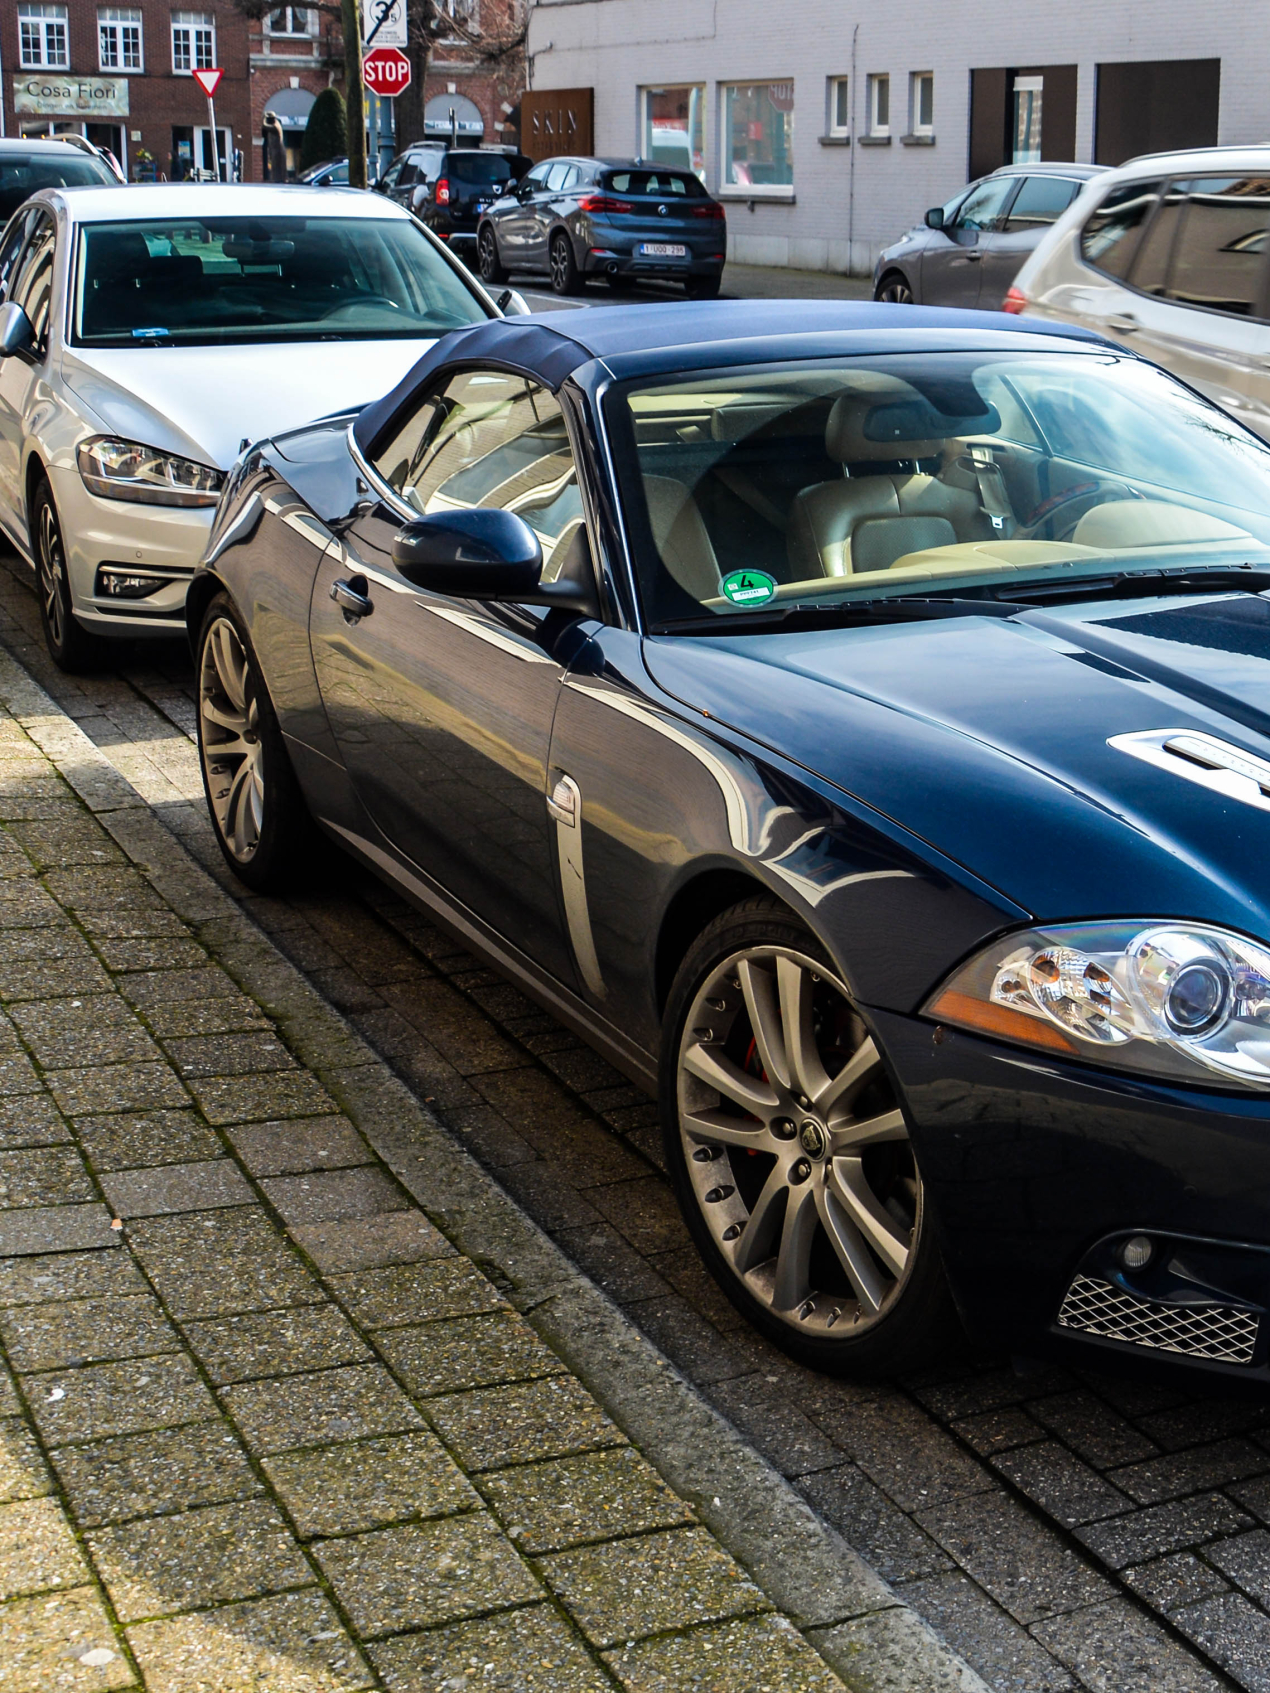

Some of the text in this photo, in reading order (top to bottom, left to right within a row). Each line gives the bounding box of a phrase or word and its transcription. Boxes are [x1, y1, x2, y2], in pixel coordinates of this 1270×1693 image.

[365, 61, 408, 82] STOP
[27, 81, 116, 99] Cosa Fiori
[532, 109, 577, 135] SKIN
[740, 575, 755, 588] 4
